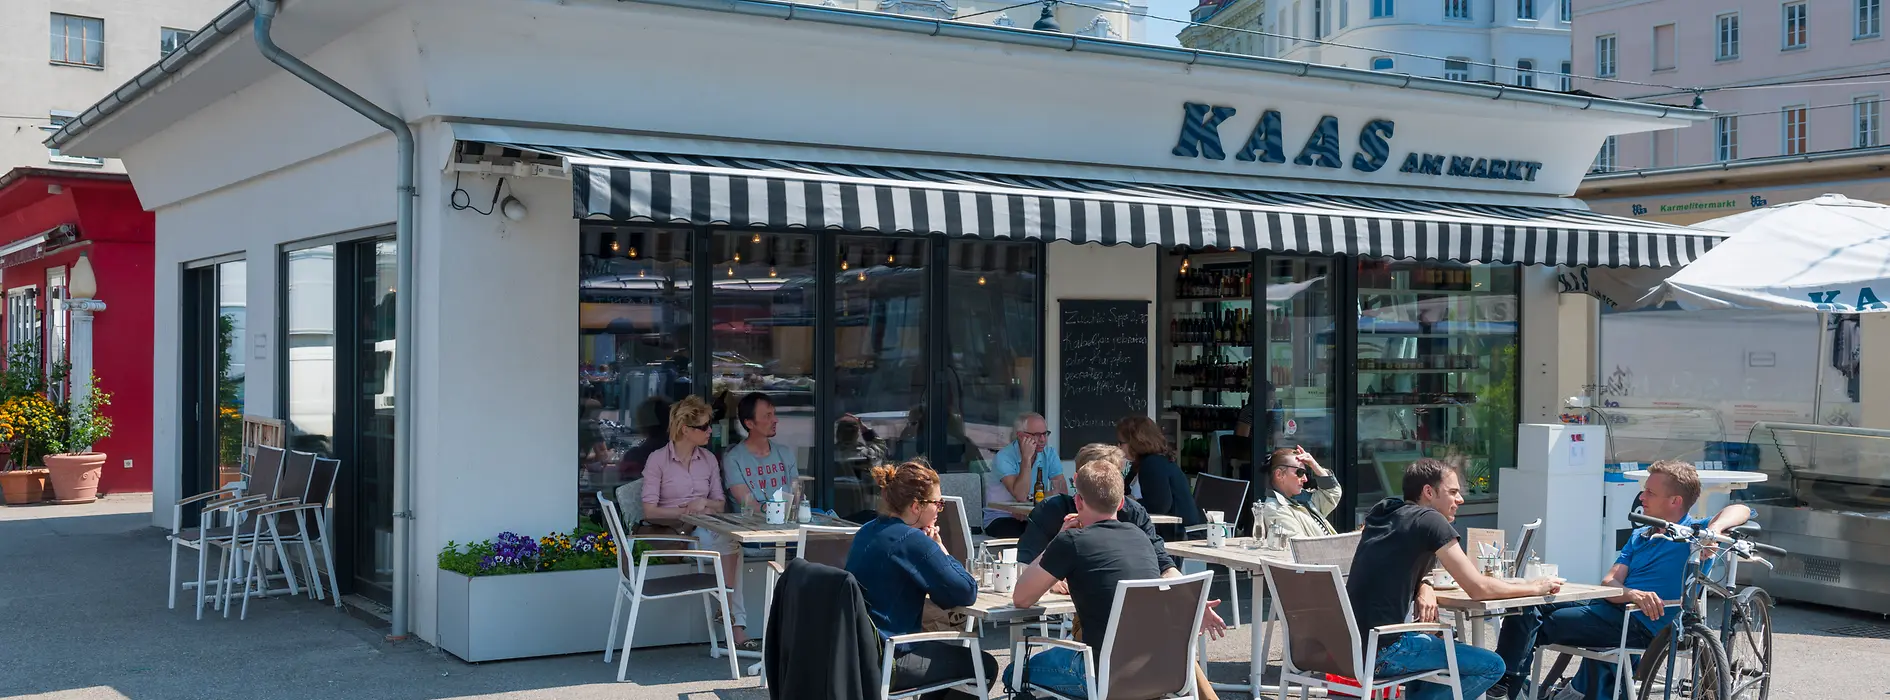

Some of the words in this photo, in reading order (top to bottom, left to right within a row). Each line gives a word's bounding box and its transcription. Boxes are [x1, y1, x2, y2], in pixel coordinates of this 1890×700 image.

[1172, 102, 1394, 172] KAAS
[1399, 152, 1446, 175] AM
[1447, 155, 1543, 182] MARKT
[1660, 200, 1736, 213] Karmelitermarkt
[757, 462, 785, 476] BORG
